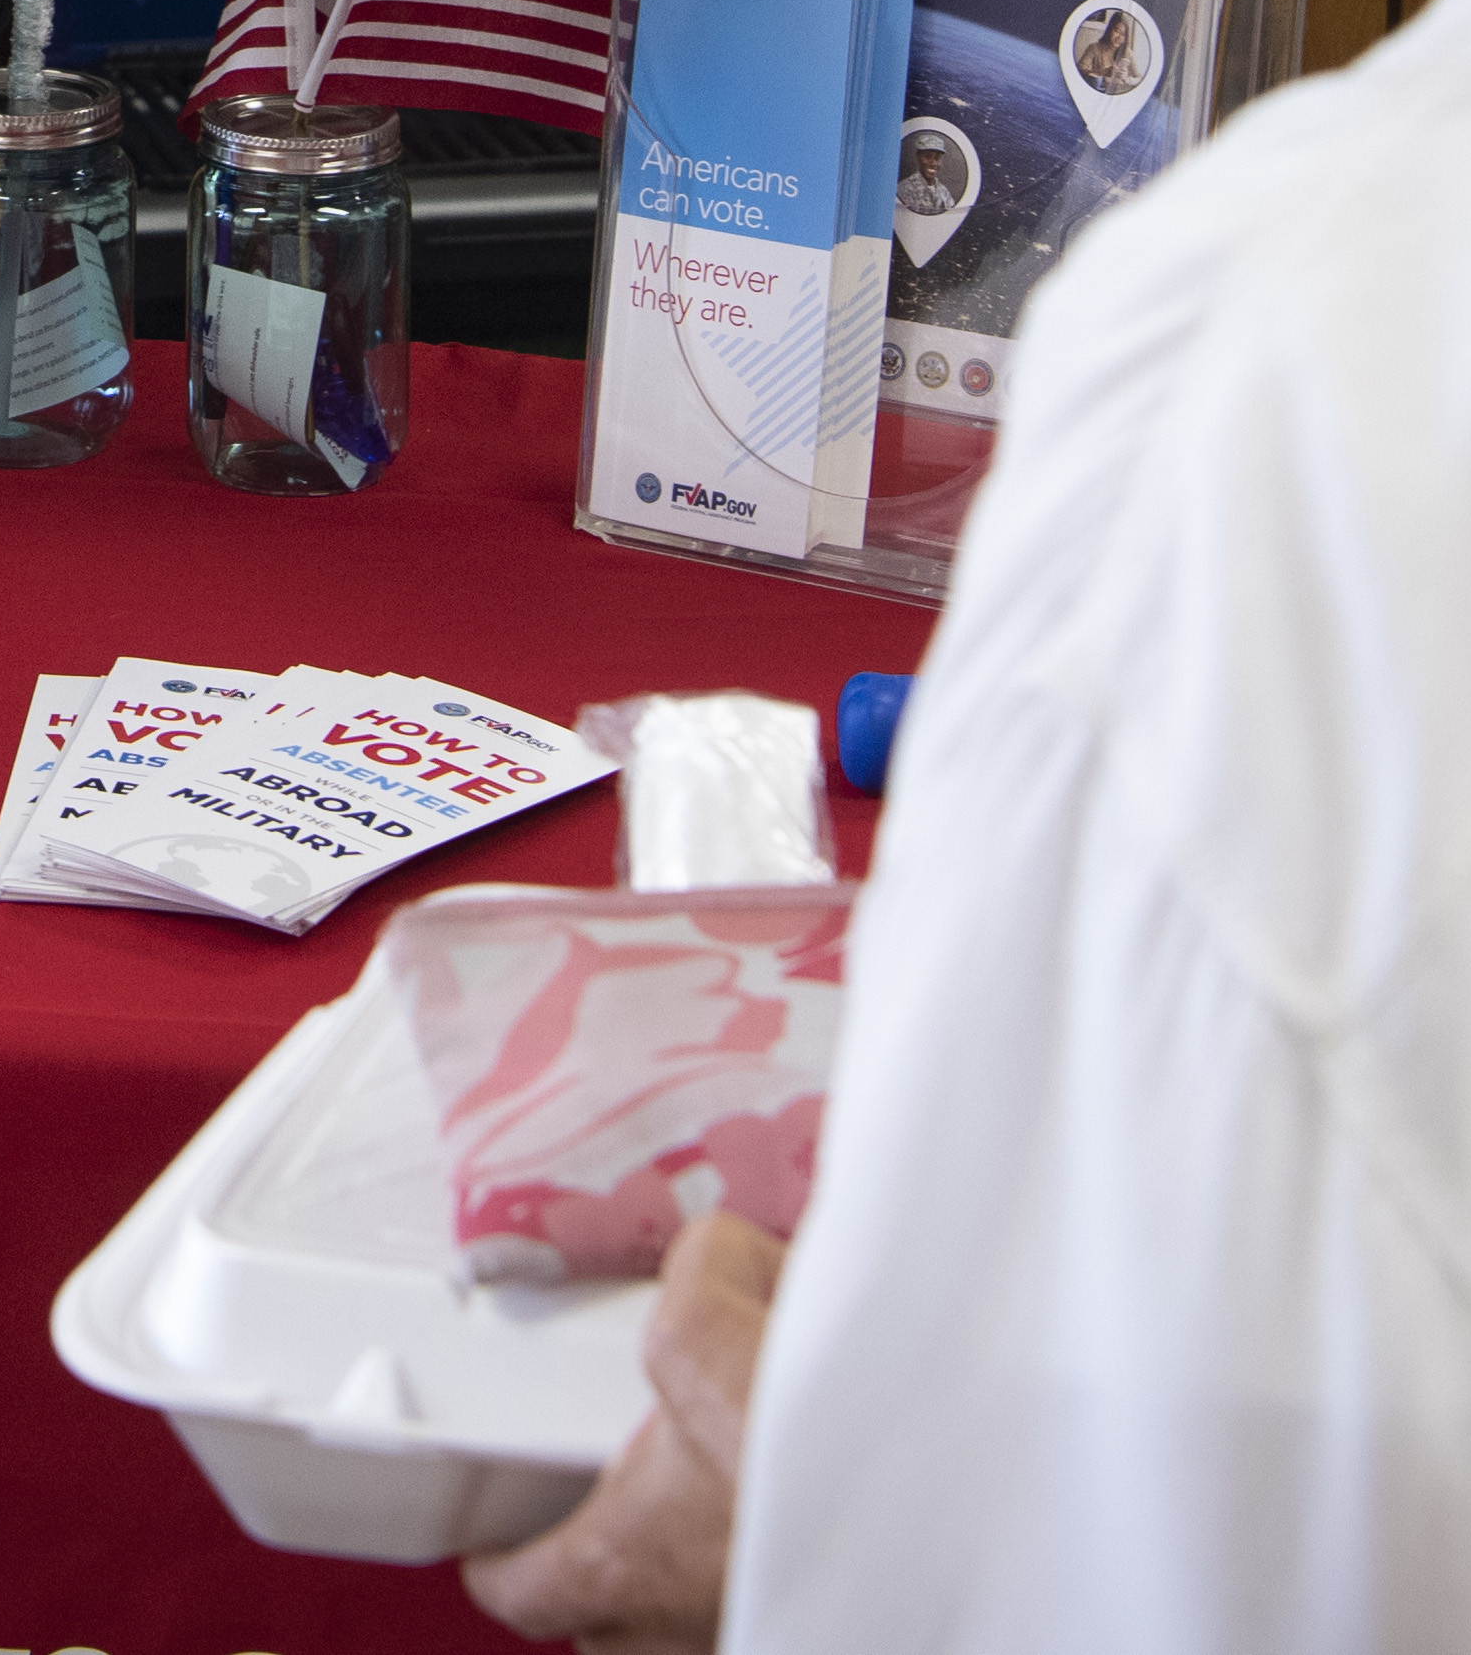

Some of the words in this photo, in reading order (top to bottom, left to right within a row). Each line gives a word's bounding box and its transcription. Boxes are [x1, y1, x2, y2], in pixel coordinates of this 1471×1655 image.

[641, 141, 799, 198] Americans
[639, 187, 689, 215] can
[698, 198, 769, 230] vote.
[634, 239, 779, 295] Wherever
[630, 276, 693, 325] they
[700, 299, 753, 329] are.
[322, 723, 517, 806] VOTE
[352, 709, 481, 753] HOW
[482, 753, 547, 785] TO
[218, 766, 413, 839] ABROAD
[272, 745, 471, 819] ABSENTEE
[315, 776, 374, 803] WHILE
[167, 787, 364, 859] MILITARY
[246, 793, 273, 807] OR
[275, 803, 296, 815] IN
[299, 812, 331, 831] THE
